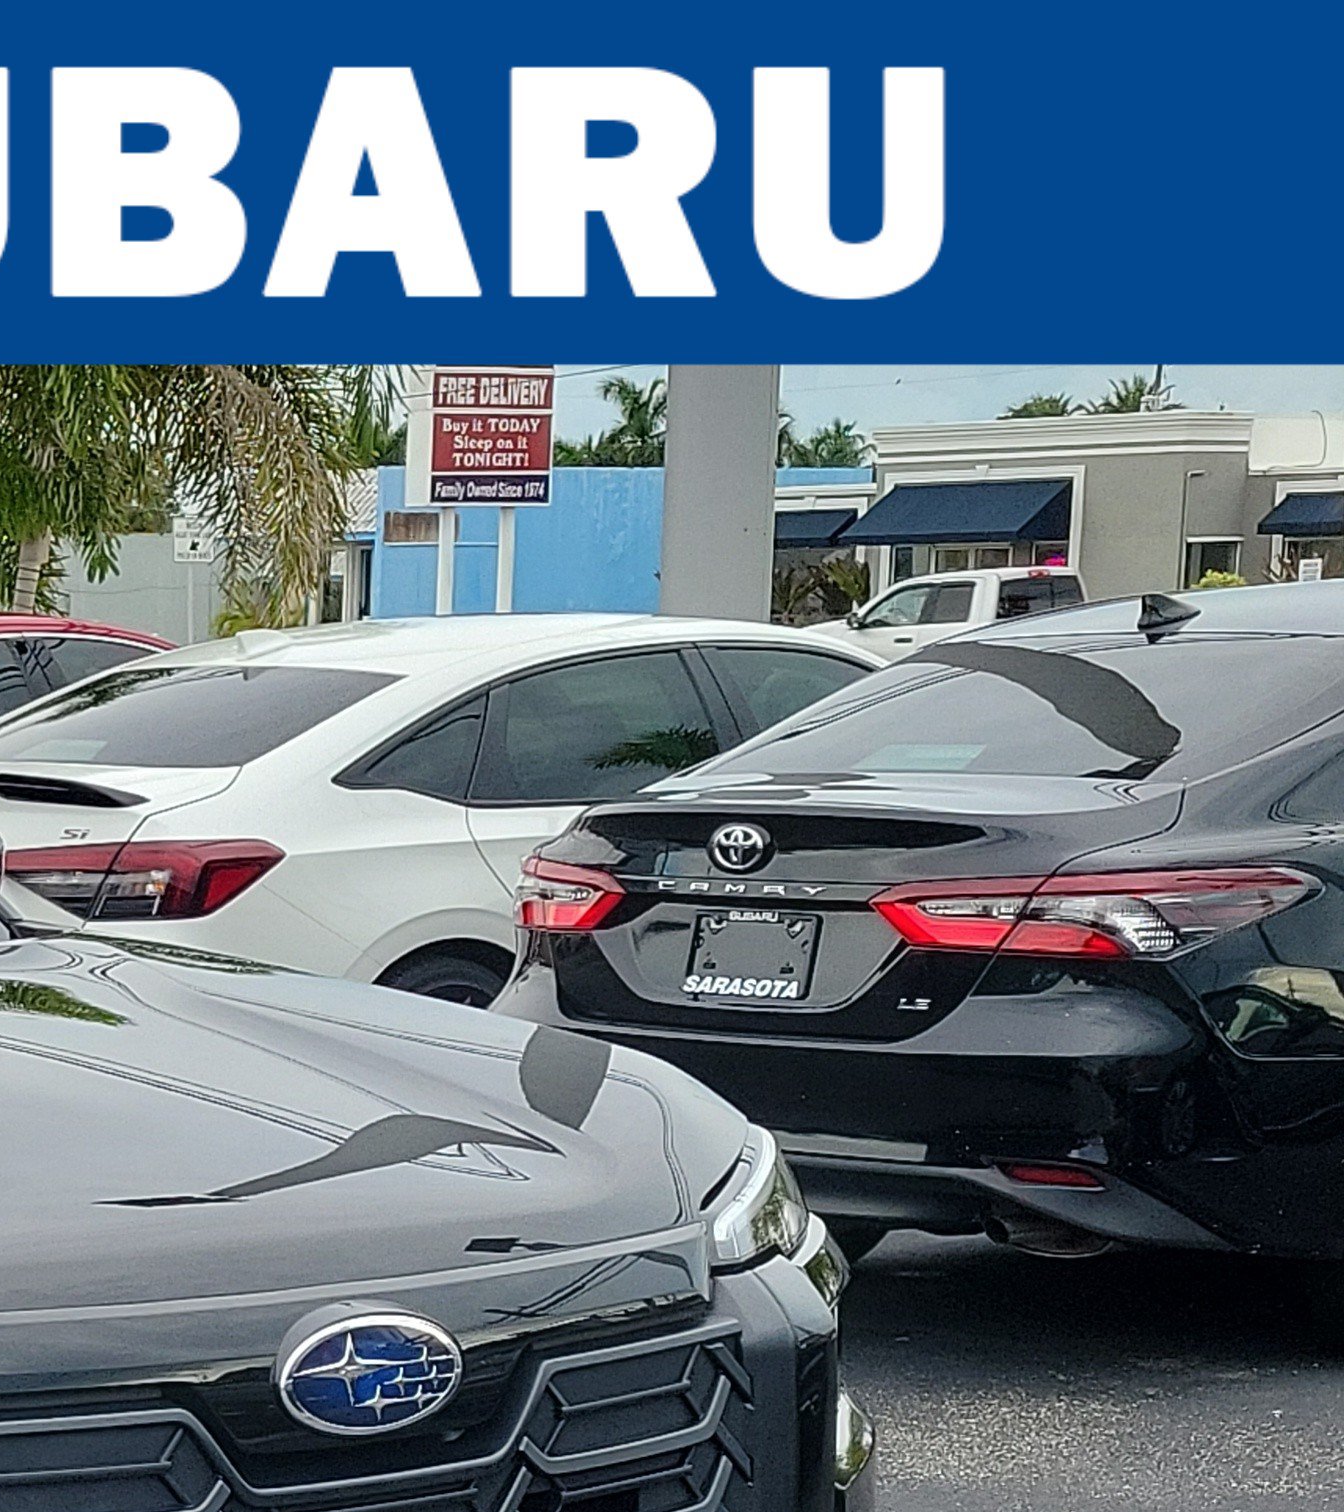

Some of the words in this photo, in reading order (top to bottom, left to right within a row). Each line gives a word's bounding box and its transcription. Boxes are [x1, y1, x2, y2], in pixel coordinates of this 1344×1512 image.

[438, 376, 476, 405] FREE
[479, 377, 548, 405] DELIVERY
[442, 418, 469, 434] Buy
[472, 418, 483, 432] it
[487, 418, 541, 433] TODAY
[453, 435, 493, 451] Sleep
[496, 438, 514, 449] on
[517, 435, 528, 449] it
[452, 453, 530, 467] TONIGHT!
[434, 482, 465, 500] Family
[498, 482, 523, 498] Since
[60, 828, 91, 840] Si
[658, 880, 826, 895] CAMRY
[729, 911, 779, 923] SUBARU
[682, 975, 800, 999] SARASOTA
